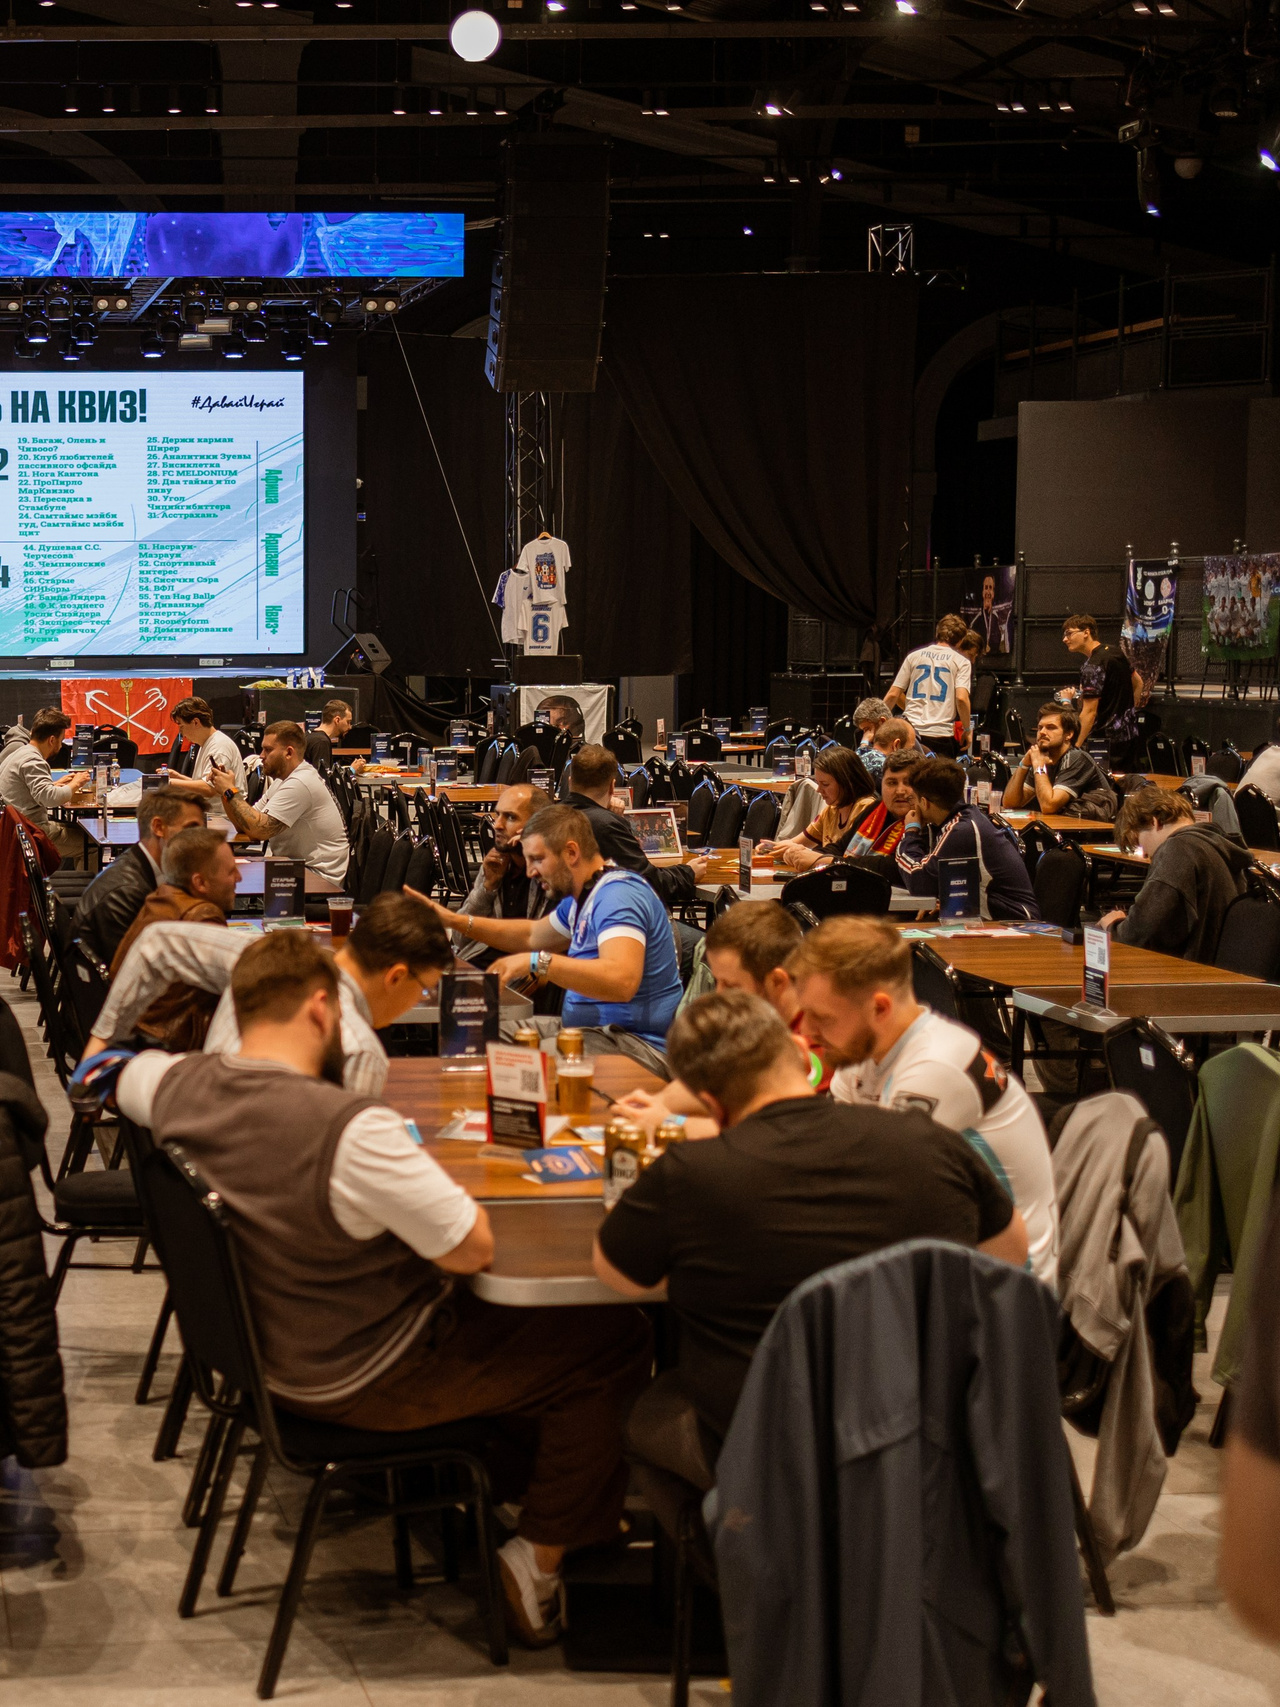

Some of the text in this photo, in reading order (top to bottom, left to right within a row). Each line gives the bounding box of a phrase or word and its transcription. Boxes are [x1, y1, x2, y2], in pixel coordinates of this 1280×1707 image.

[11, 390, 50, 423] НА
[58, 388, 147, 423] КВИЗ!
[261, 469, 283, 504] Афиша
[261, 533, 282, 576] Аршавин
[532, 612, 550, 643] 6
[912, 664, 950, 702] 25
